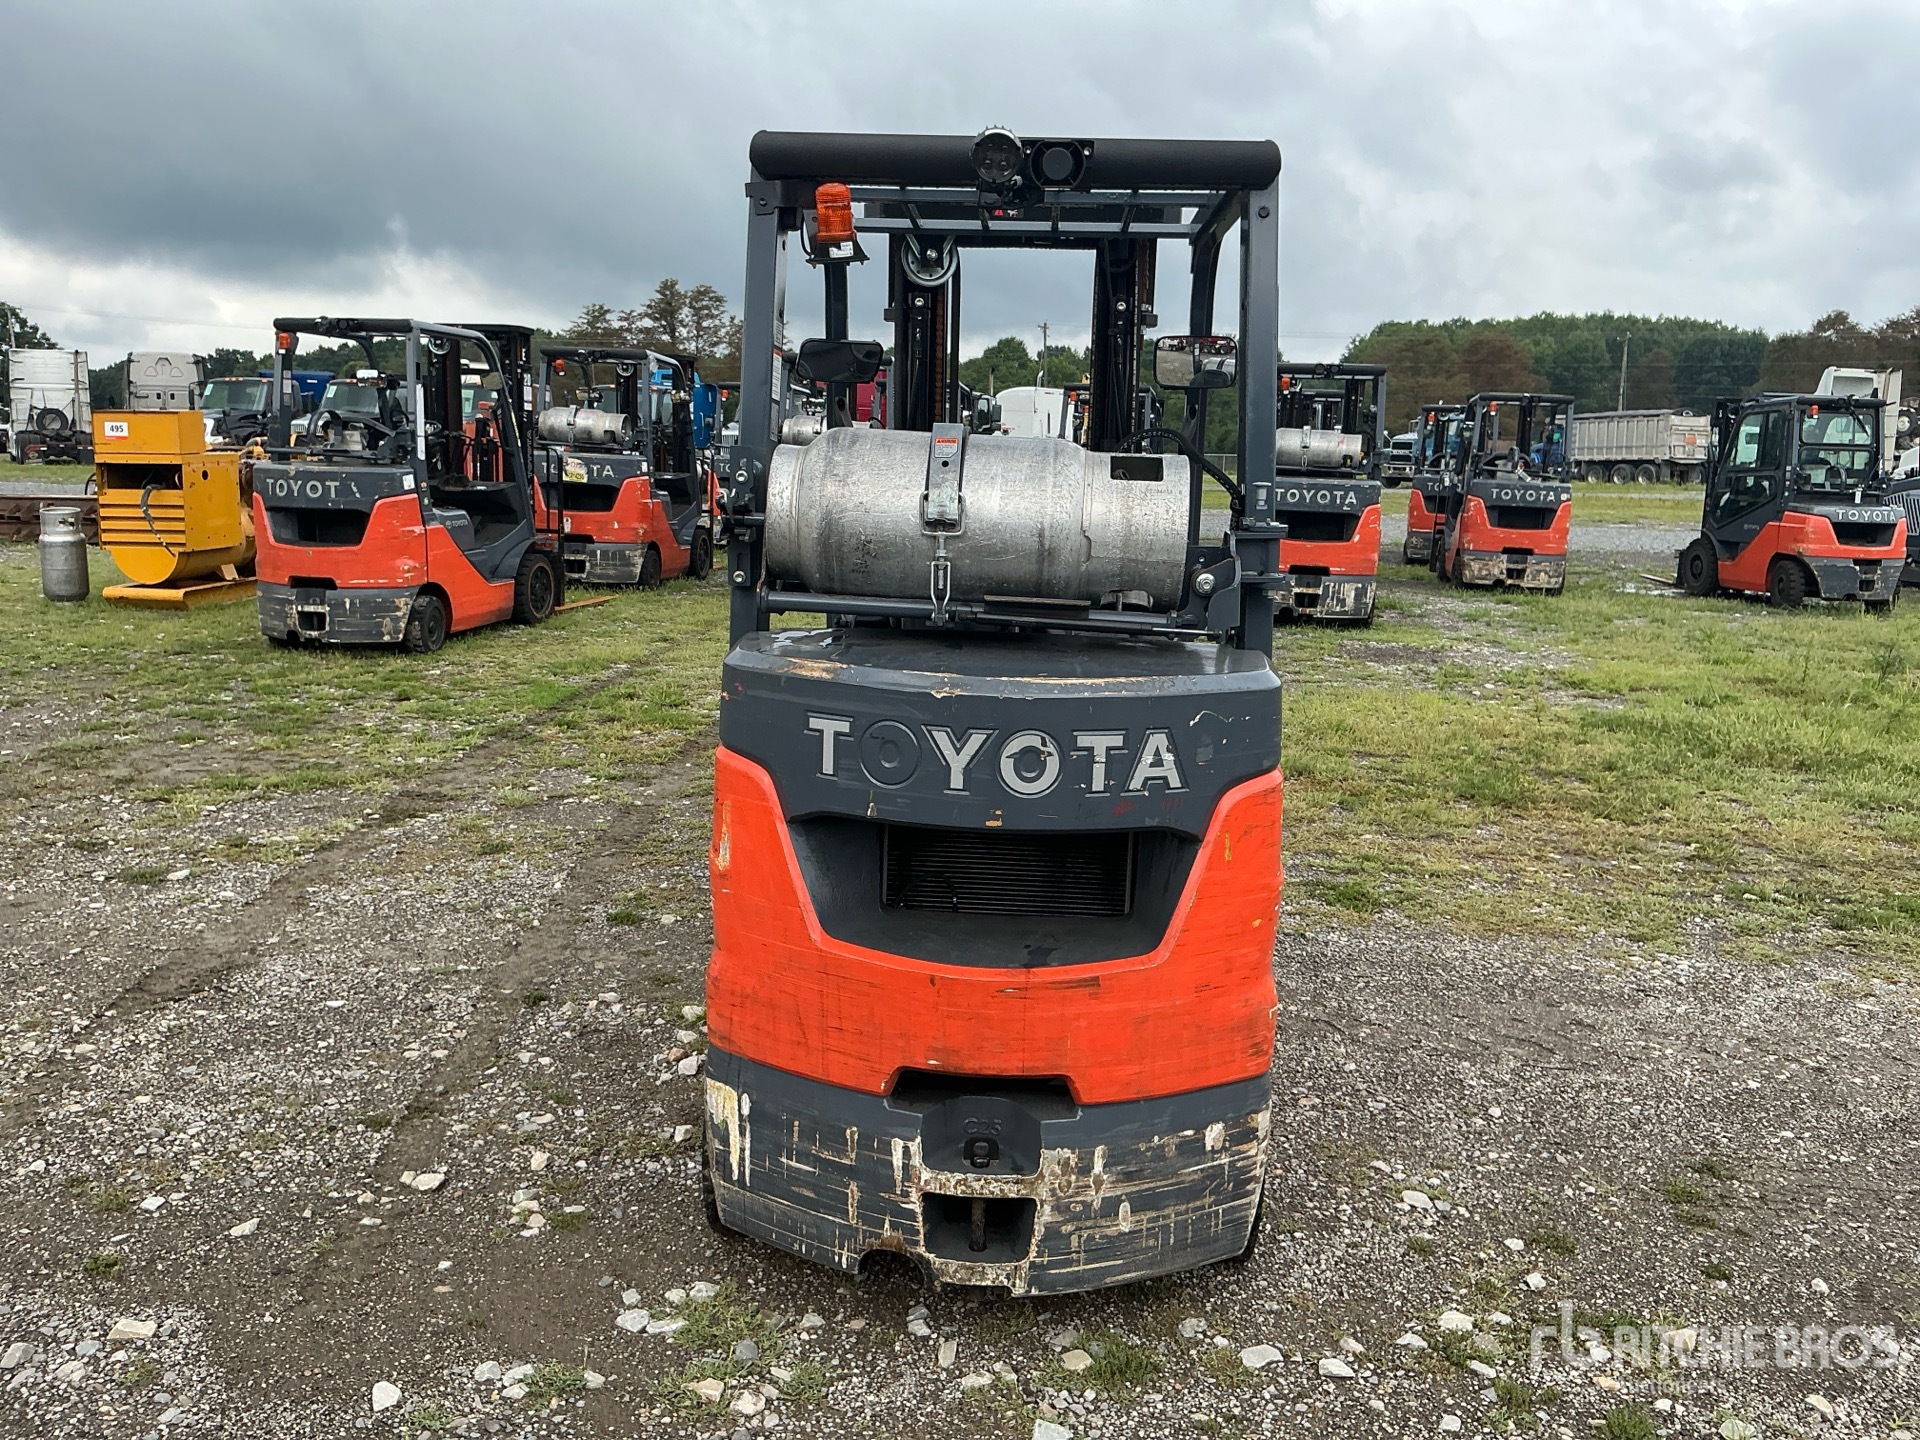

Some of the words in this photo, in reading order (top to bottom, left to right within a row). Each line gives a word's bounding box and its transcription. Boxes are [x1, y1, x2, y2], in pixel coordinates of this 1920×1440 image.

[109, 424, 124, 433] 495
[541, 462, 615, 478] TOTA
[1275, 488, 1358, 506] TOYOTA
[1490, 488, 1556, 503] TOYOTA
[1836, 508, 1896, 522] TOYOTA
[803, 711, 1191, 798] TOYOTA
